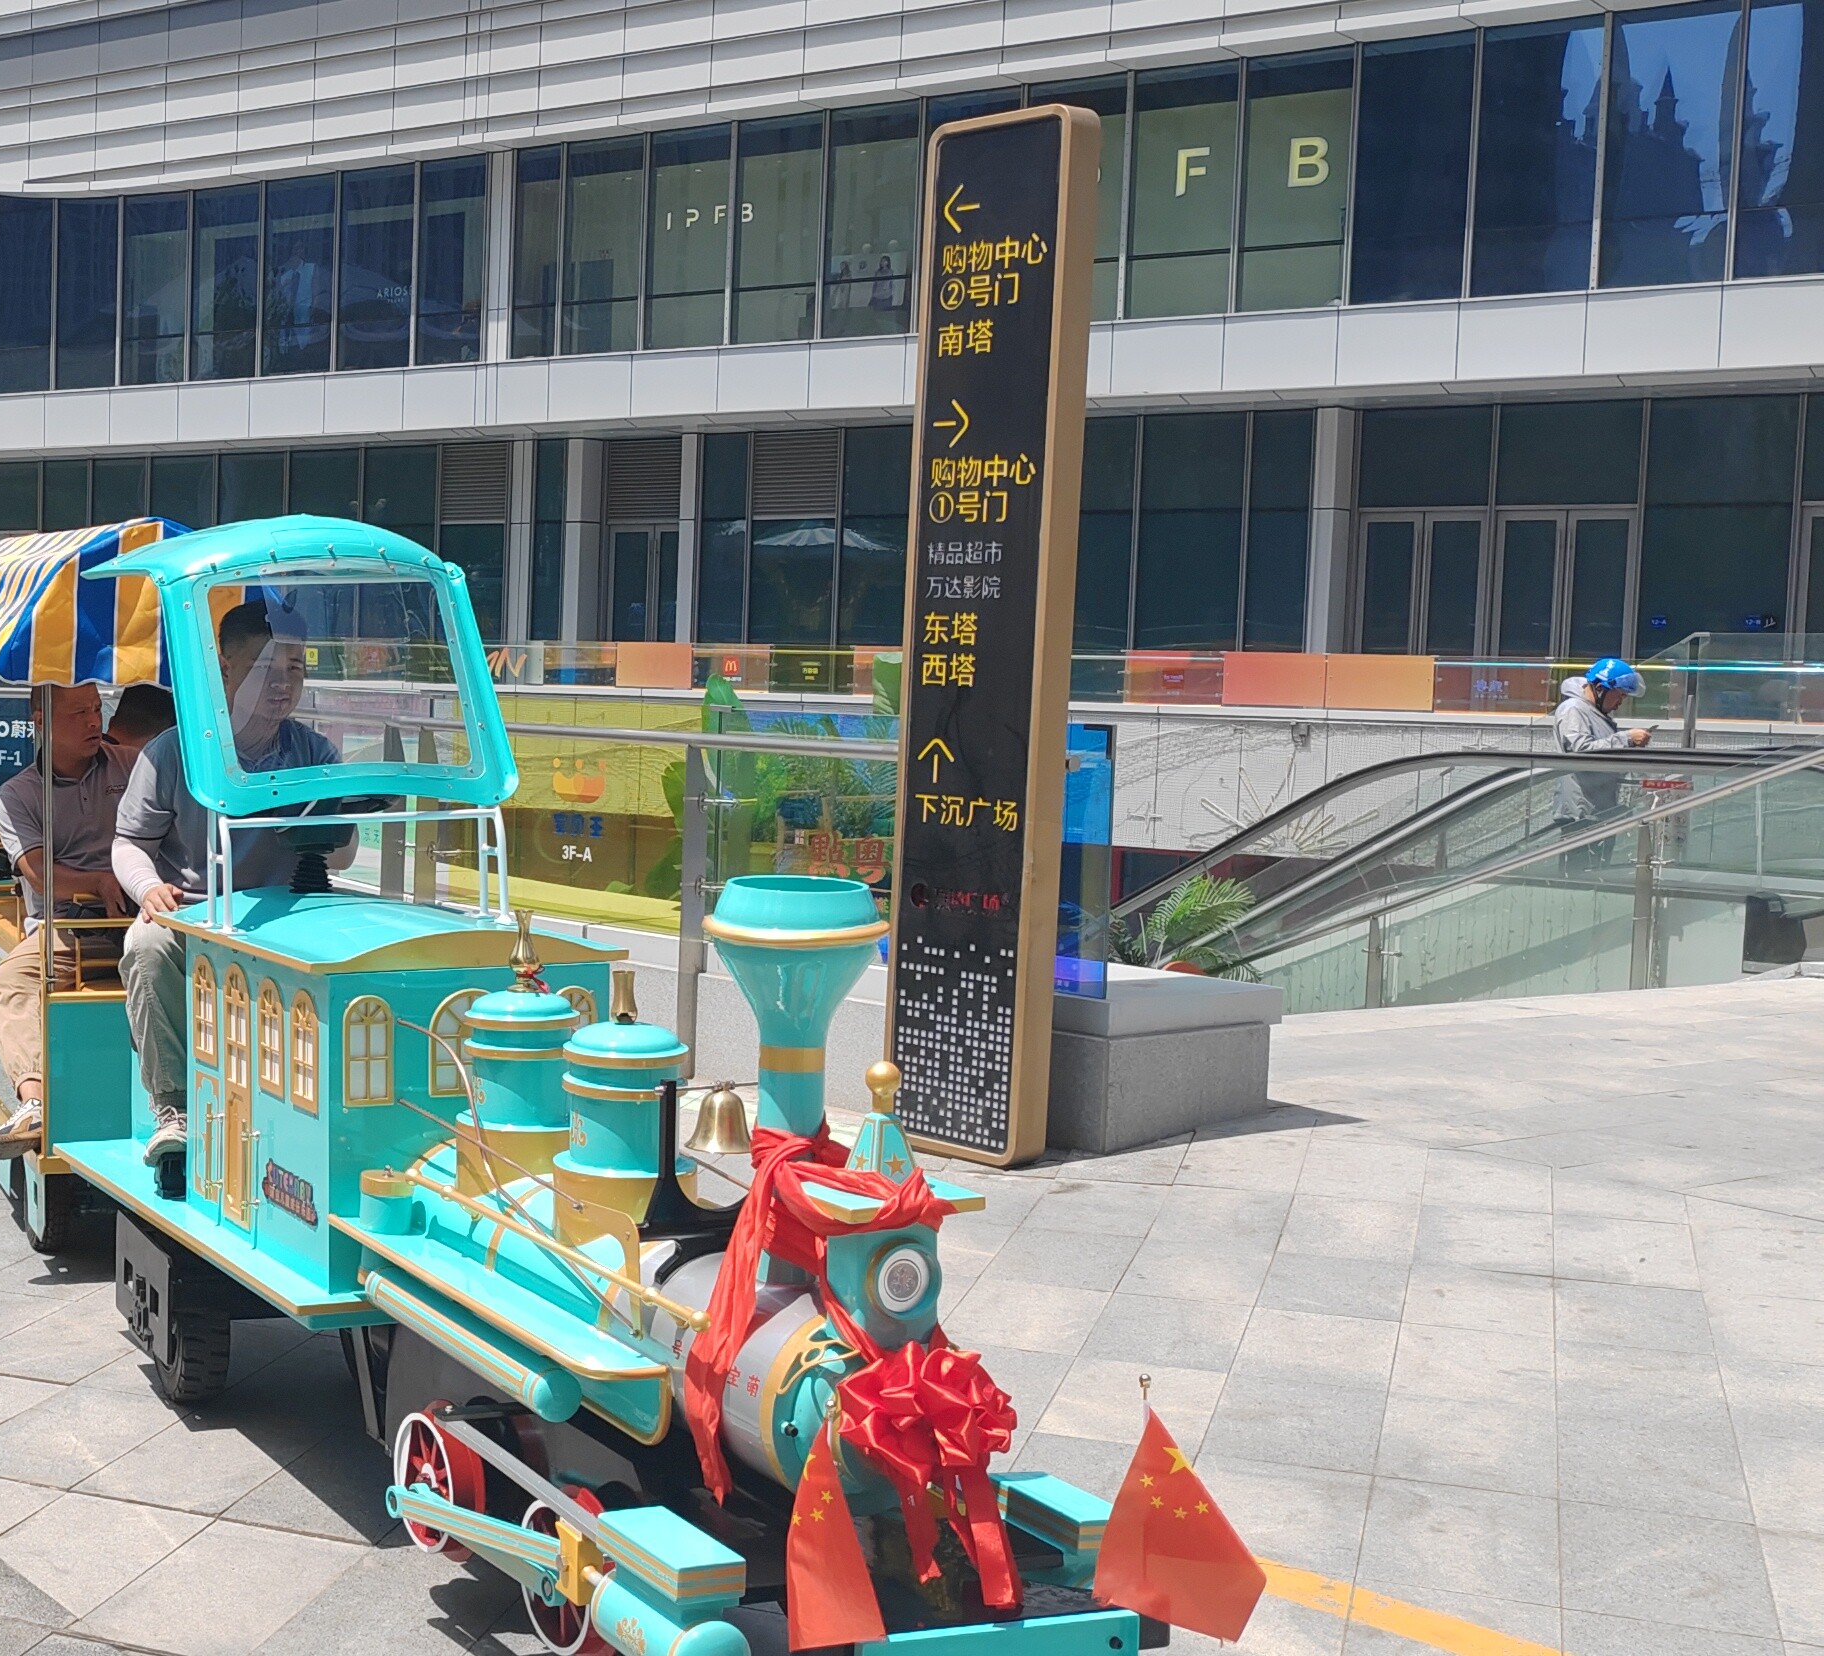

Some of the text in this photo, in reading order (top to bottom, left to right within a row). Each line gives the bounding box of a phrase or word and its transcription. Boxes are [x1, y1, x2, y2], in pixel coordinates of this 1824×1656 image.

[942, 232, 1048, 276] 购物中心
[938, 319, 994, 357] 南塔
[930, 453, 1037, 489] 购物中心
[927, 541, 1003, 565] 精品超市
[925, 576, 1001, 599] 万达影院
[923, 611, 978, 646] 东塔
[921, 653, 976, 688] 西塔
[915, 793, 1019, 832] 下沉广场
[562, 845, 592, 862] 3F-A
